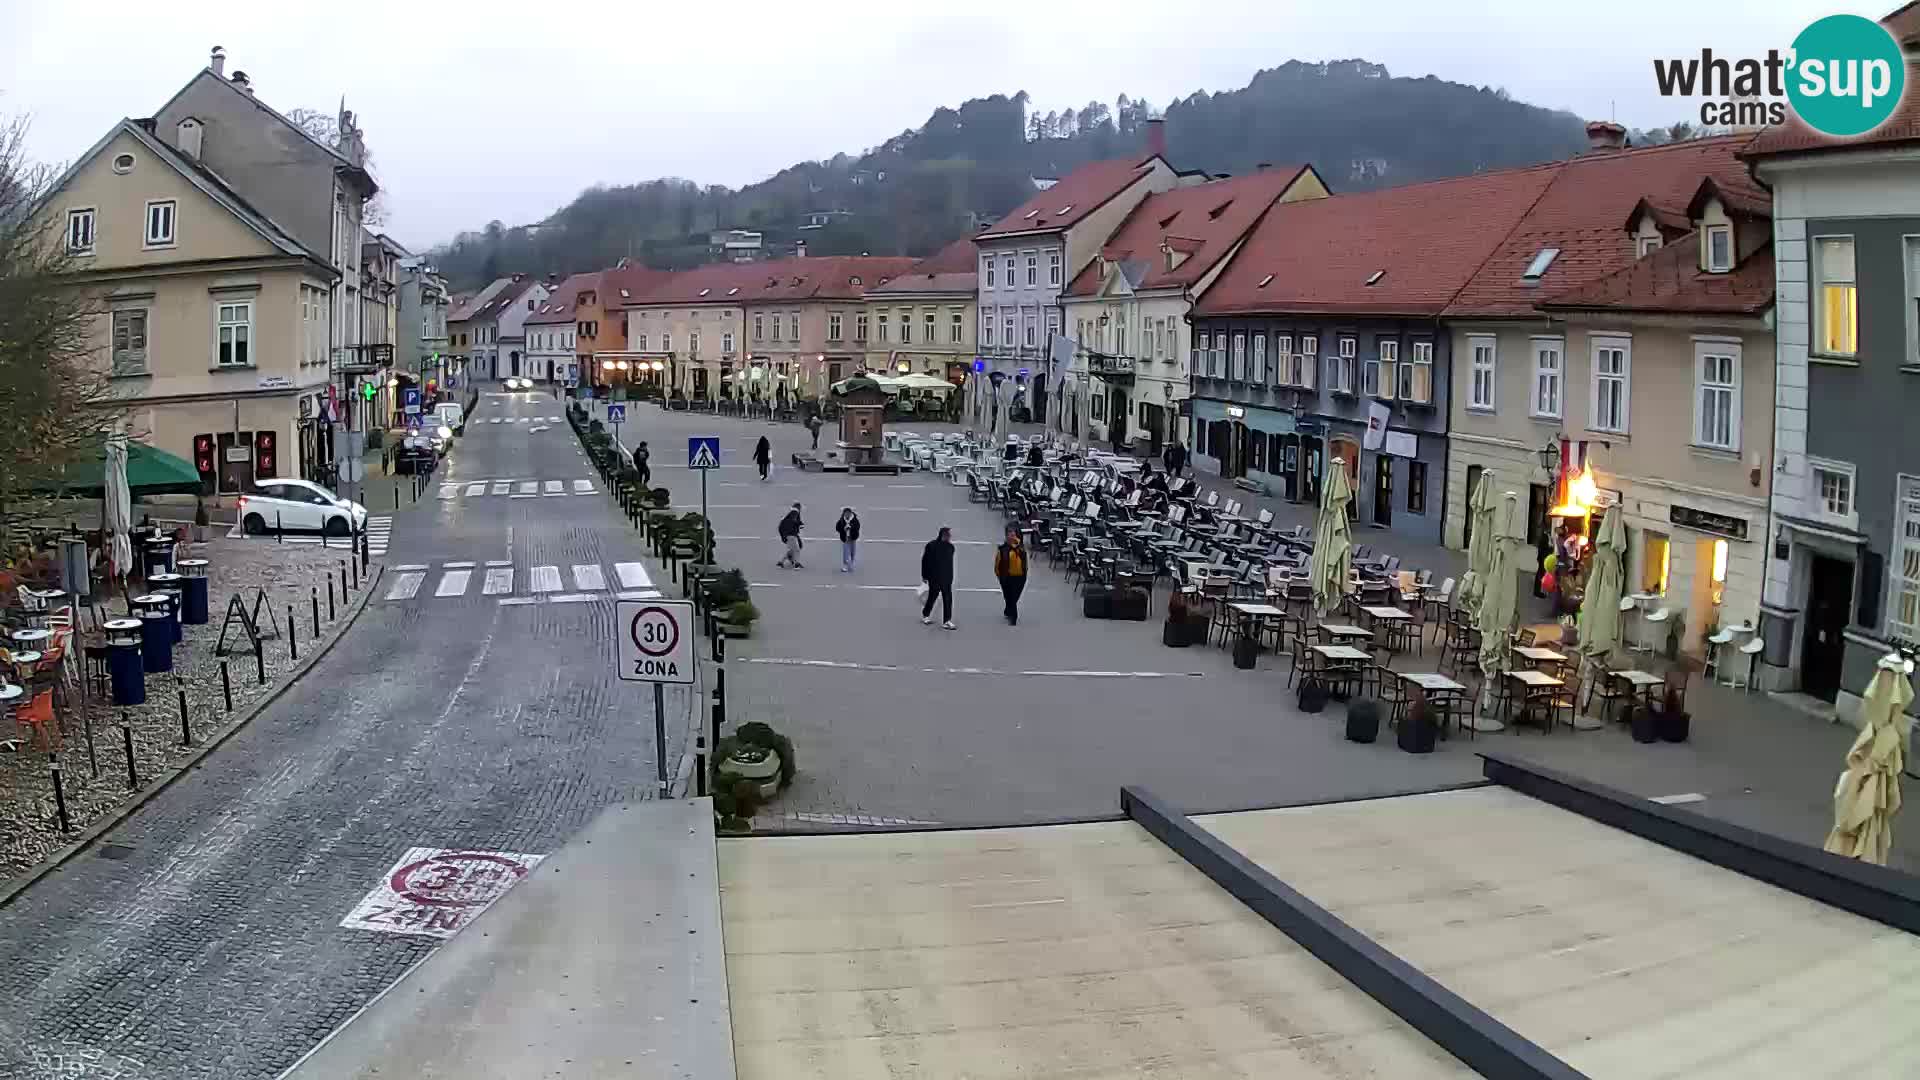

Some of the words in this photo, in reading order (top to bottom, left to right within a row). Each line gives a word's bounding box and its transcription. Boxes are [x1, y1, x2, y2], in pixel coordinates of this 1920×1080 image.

[408, 391, 416, 403] P
[643, 622, 667, 644] 30
[634, 659, 678, 677] ZONA
